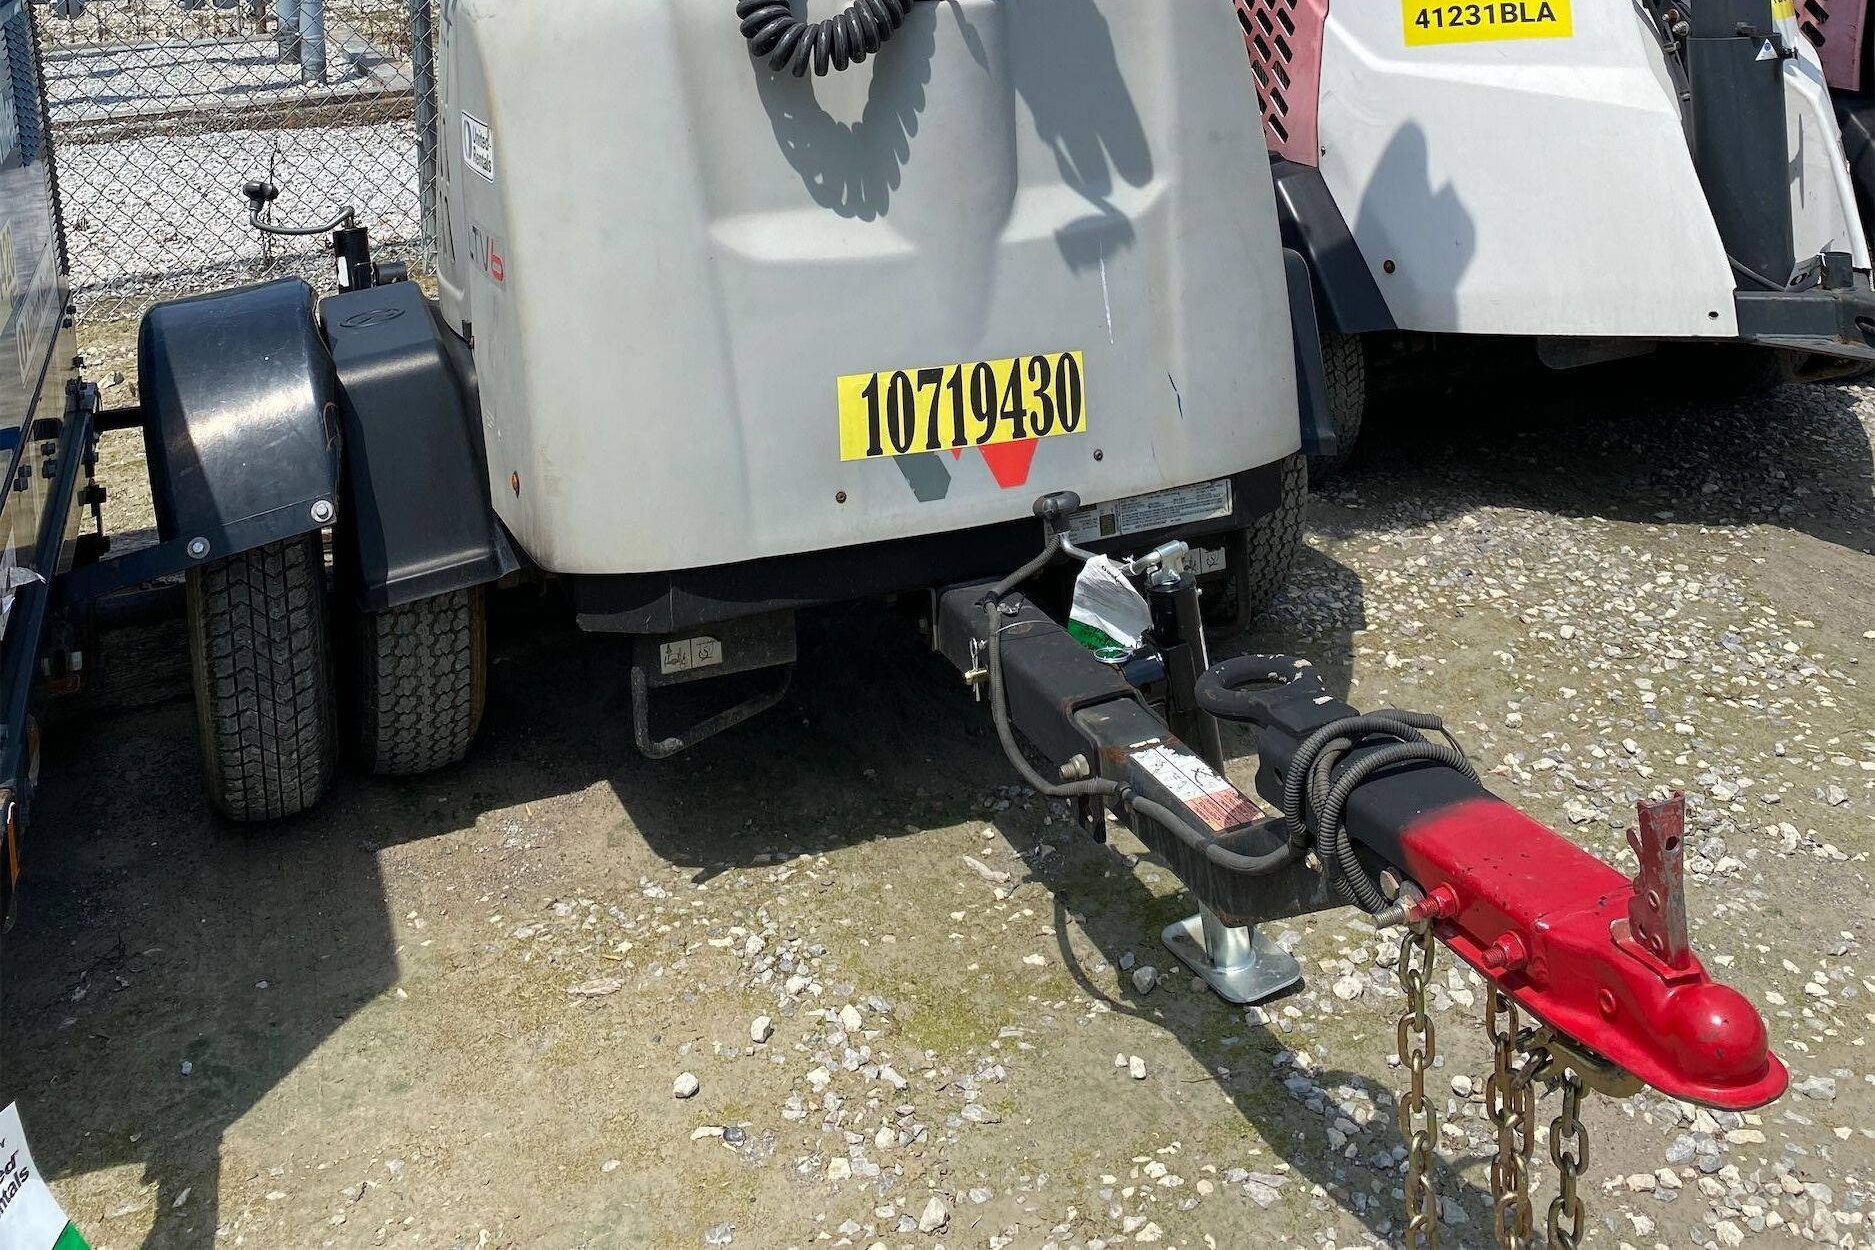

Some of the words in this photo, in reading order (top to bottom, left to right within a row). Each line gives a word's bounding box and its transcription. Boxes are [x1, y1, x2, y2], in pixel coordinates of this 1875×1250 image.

[1415, 1, 1557, 29] 41231BLA
[861, 352, 1082, 457] 10719430
[0, 1166, 30, 1214] ntals
